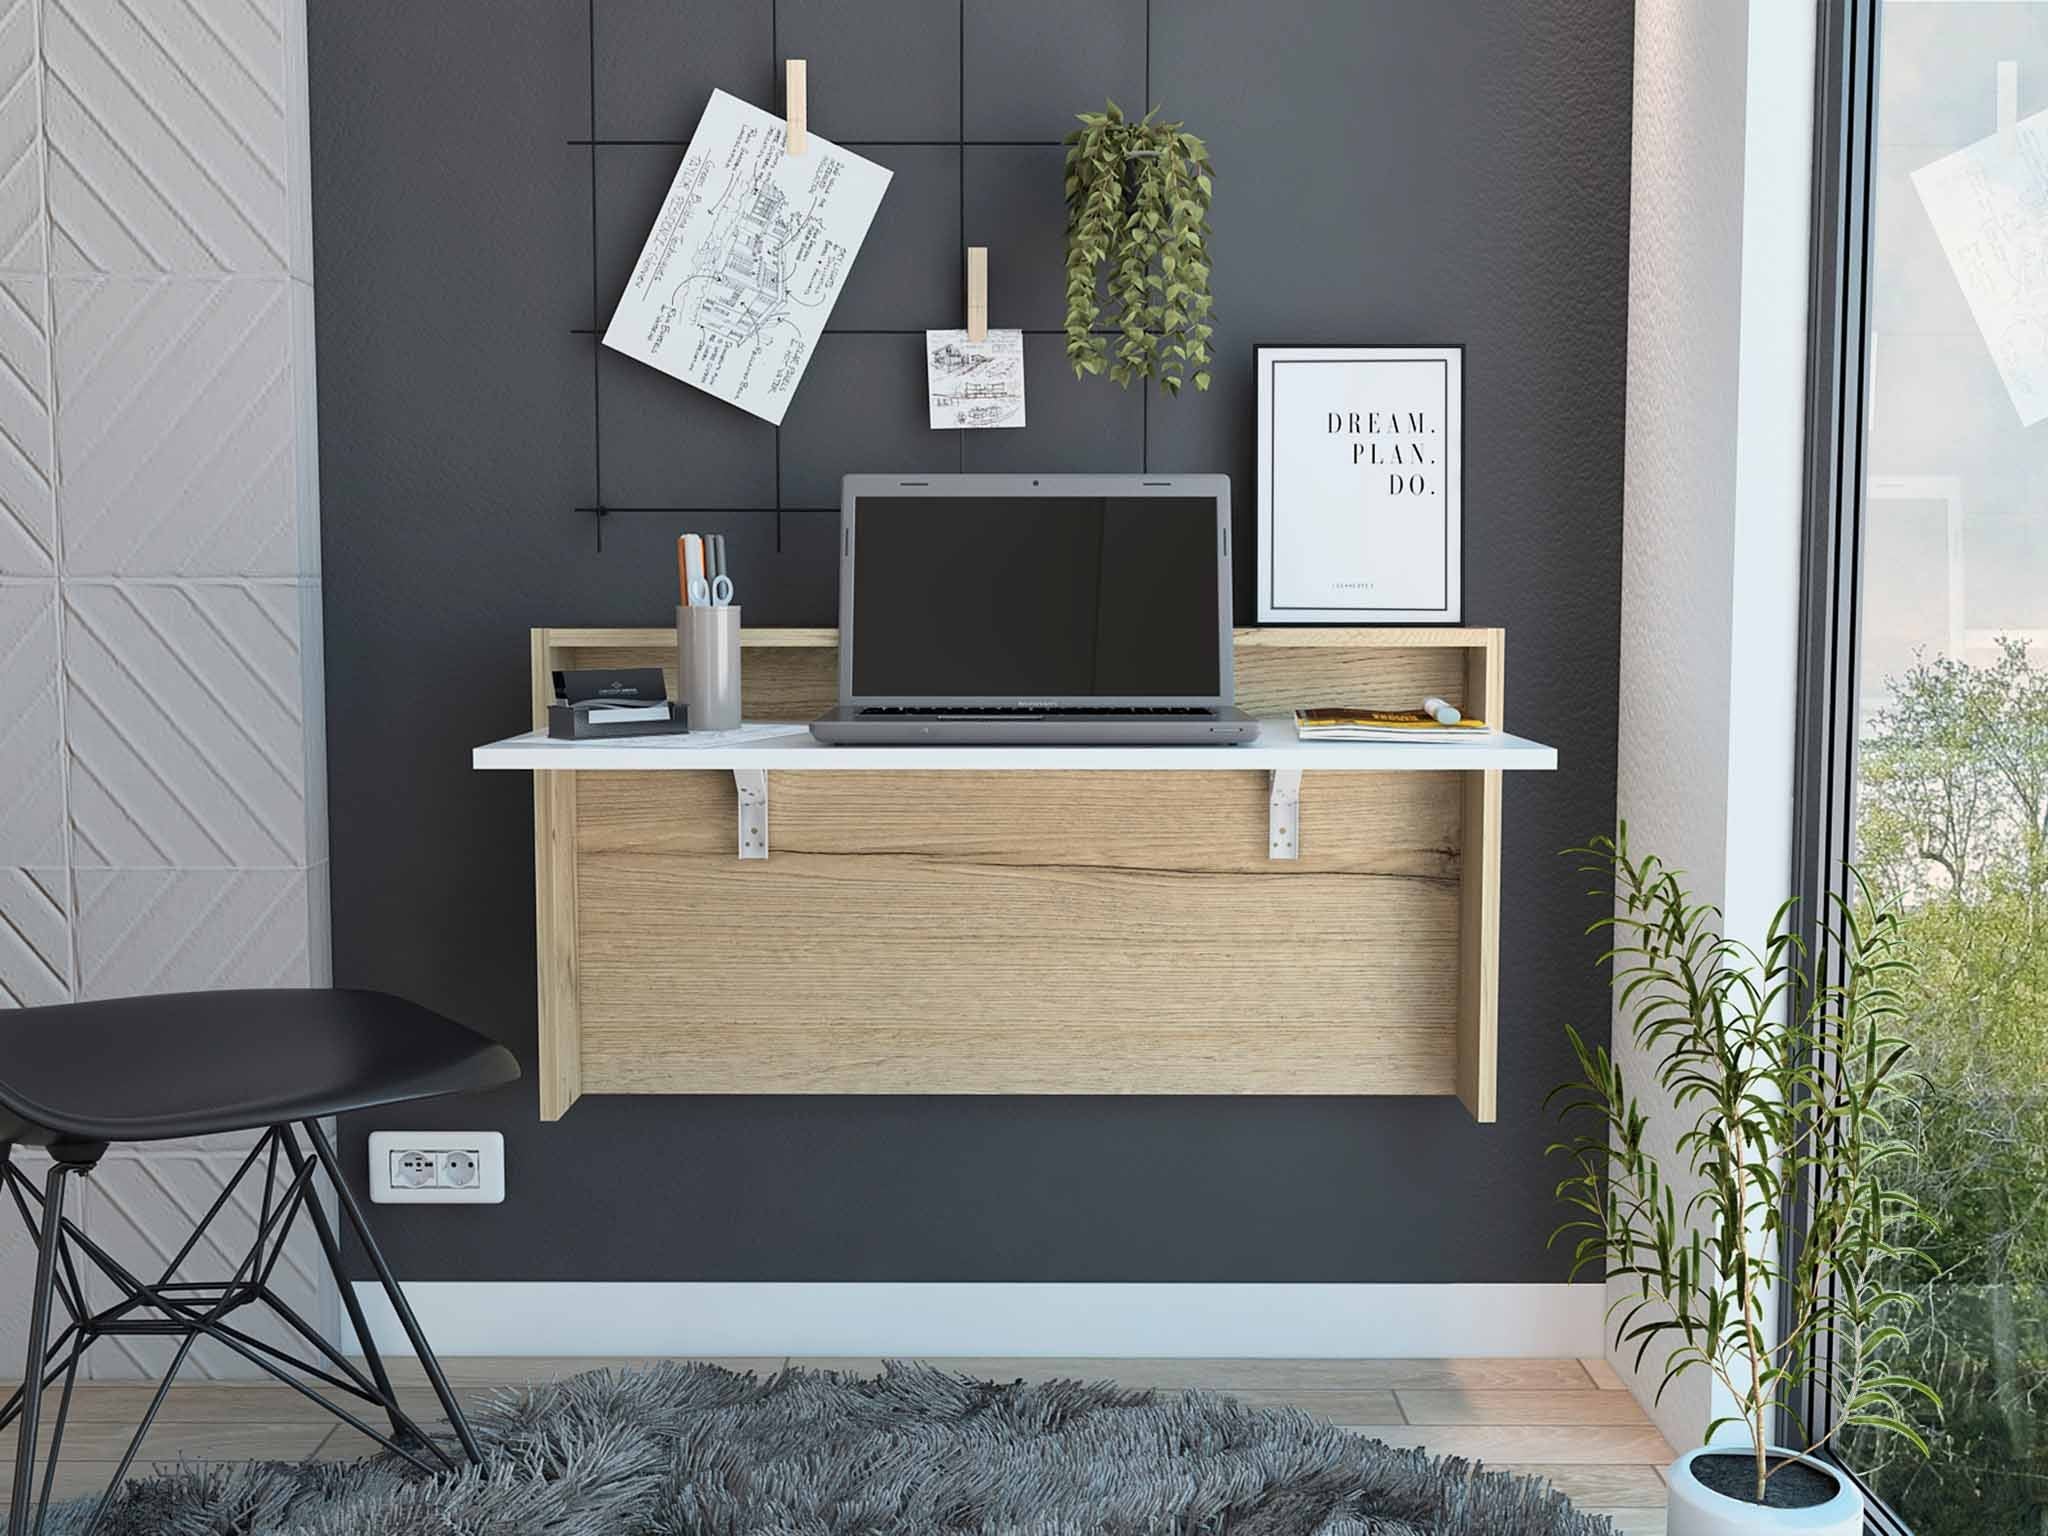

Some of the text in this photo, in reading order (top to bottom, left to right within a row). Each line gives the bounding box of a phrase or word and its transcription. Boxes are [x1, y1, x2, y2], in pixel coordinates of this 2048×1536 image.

[1328, 412, 1435, 433] DREAM.
[1353, 442, 1435, 464] PLAN.
[1390, 473, 1435, 495] DO.
